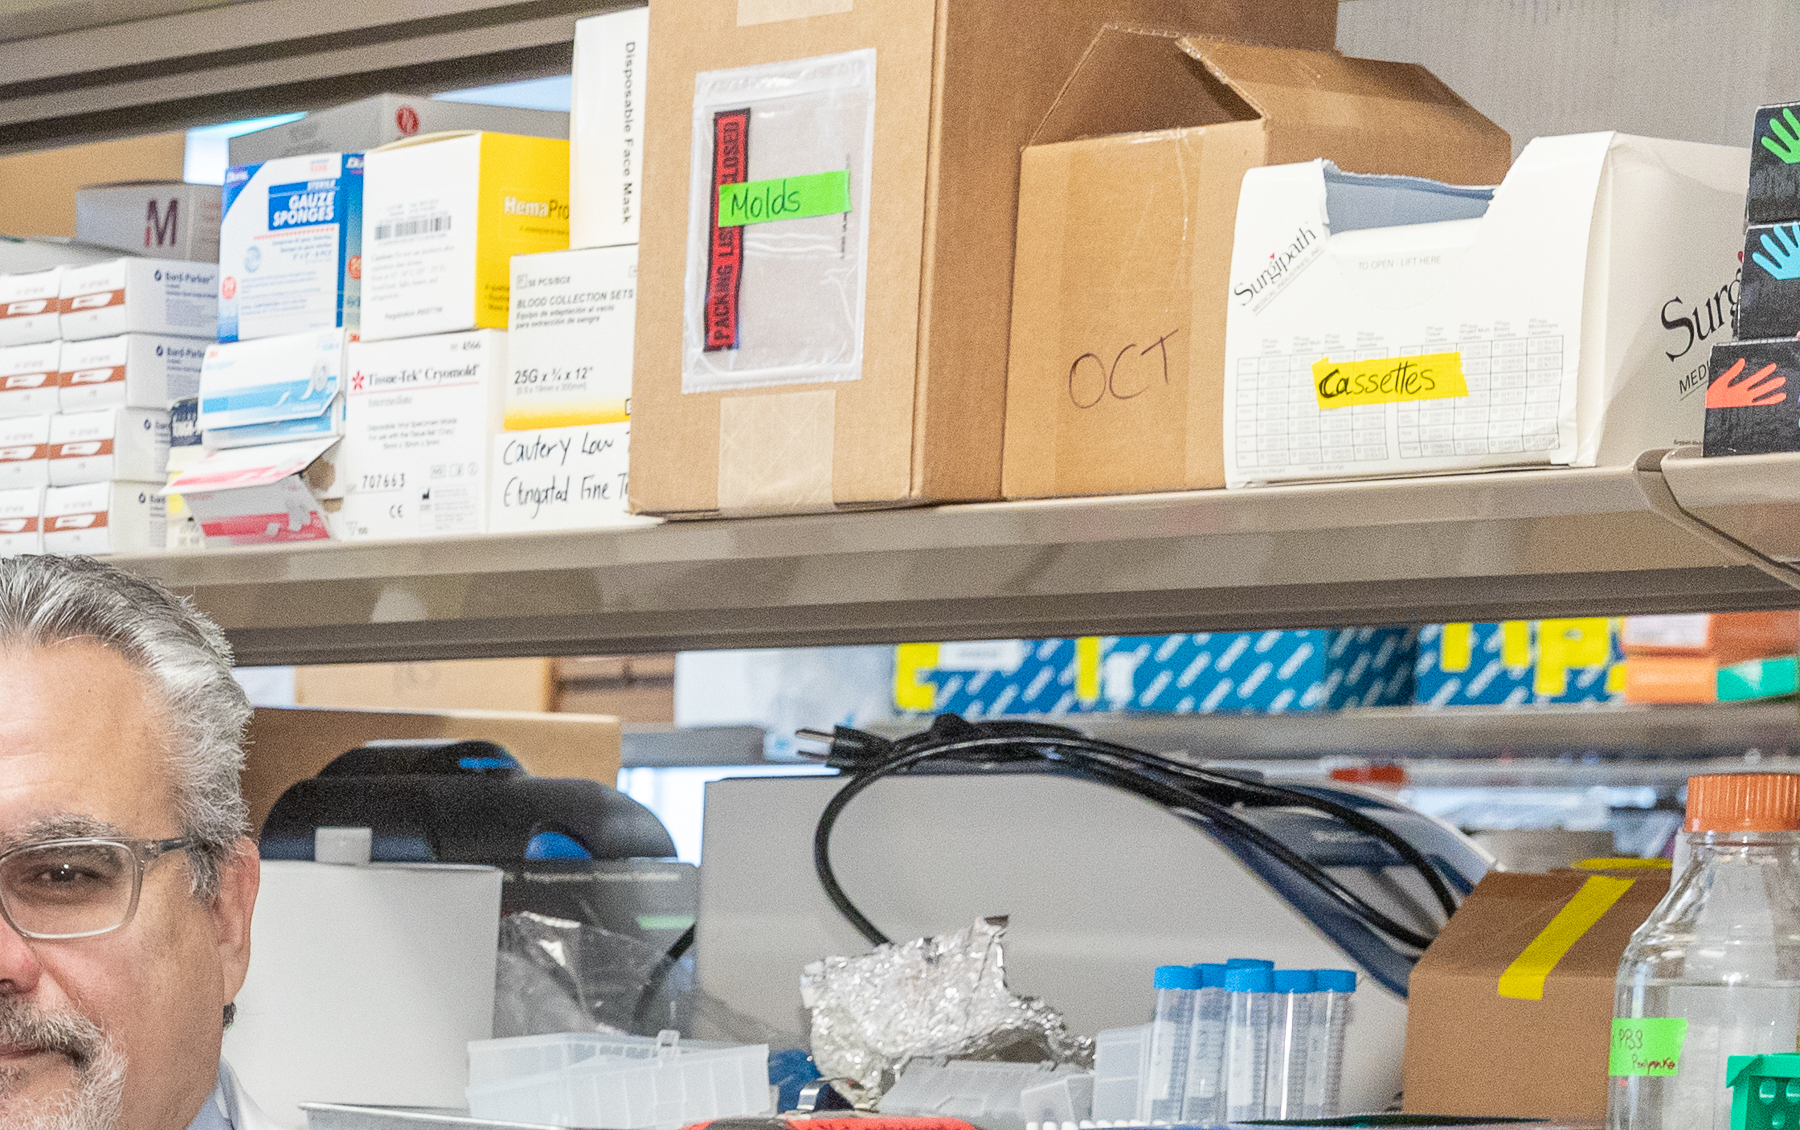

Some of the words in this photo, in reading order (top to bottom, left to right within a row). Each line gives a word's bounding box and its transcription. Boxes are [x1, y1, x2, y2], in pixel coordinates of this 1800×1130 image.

[624, 41, 636, 133] Disposable
[624, 138, 634, 177] Face
[289, 191, 335, 210] GAUZE
[622, 182, 634, 225] Mask
[731, 180, 801, 220] Molds
[273, 207, 334, 227] SPONGES
[718, 225, 734, 258] LIS
[1233, 226, 1317, 307] Surgipath
[1358, 262, 1369, 271] TO
[1371, 260, 1394, 270] OPEN
[1401, 257, 1417, 267] LIFT
[1419, 255, 1442, 265] HERE
[517, 296, 547, 309] BLOOD
[549, 291, 607, 307] COLLECTION
[610, 289, 634, 300] SETS
[713, 264, 734, 343] PACKING
[514, 368, 538, 385] 25G
[1069, 328, 1178, 409] OCT
[1319, 361, 1436, 398] Cassettes
[503, 434, 571, 467] Cautery
[362, 473, 406, 489] 707663
[581, 473, 610, 500] Fine
